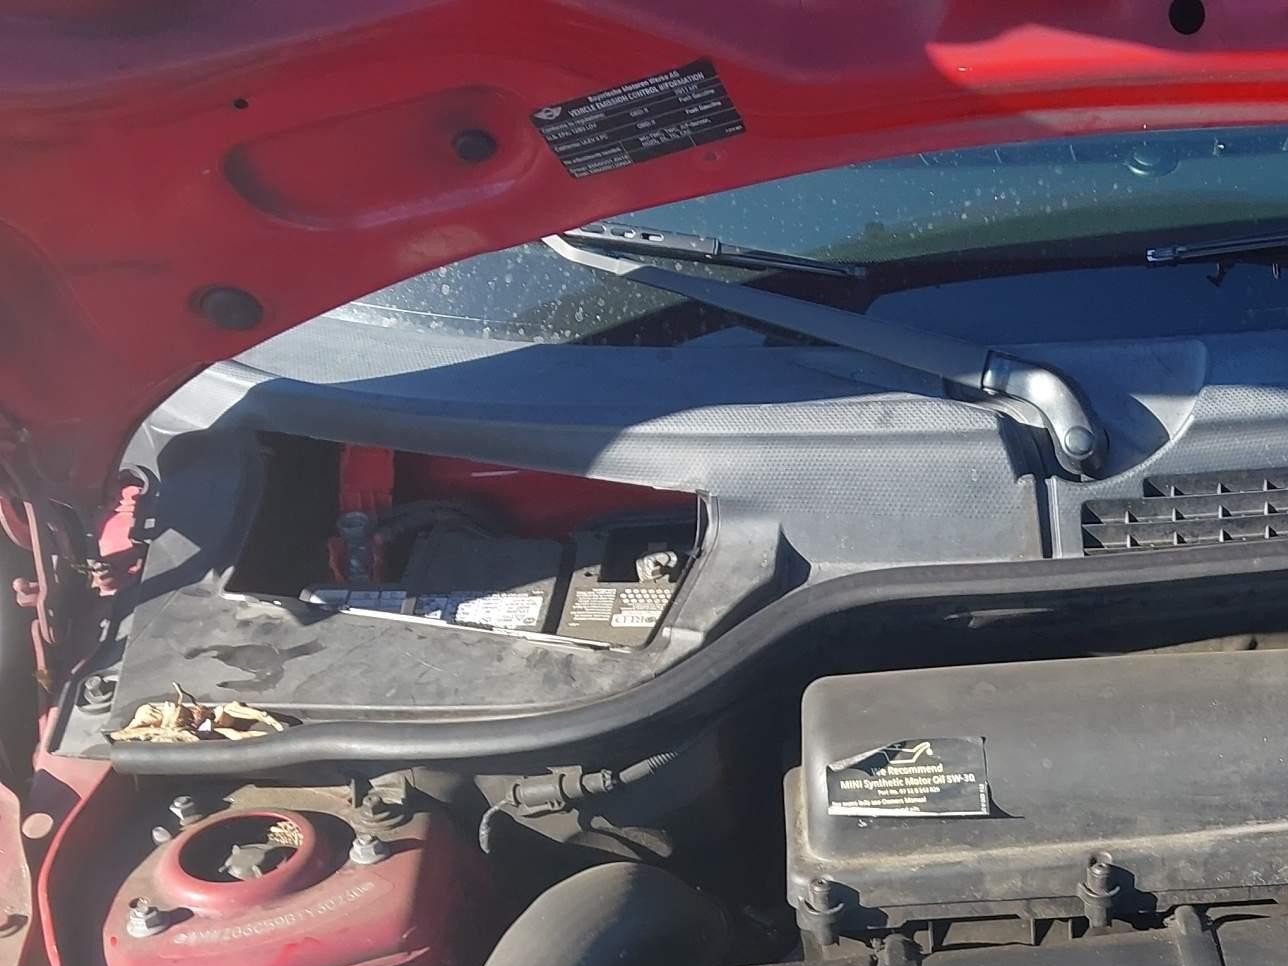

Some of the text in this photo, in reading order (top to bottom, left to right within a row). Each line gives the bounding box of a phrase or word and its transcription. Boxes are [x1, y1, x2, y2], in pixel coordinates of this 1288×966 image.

[568, 72, 705, 118] VEHICLE EMISSION CONTROL INFORMATION
[588, 70, 680, 102] Bayerische Motoren Werke AG
[840, 773, 976, 789] MINI Synthetic Motor Oil 5W-30
[887, 763, 943, 776] Recommend
